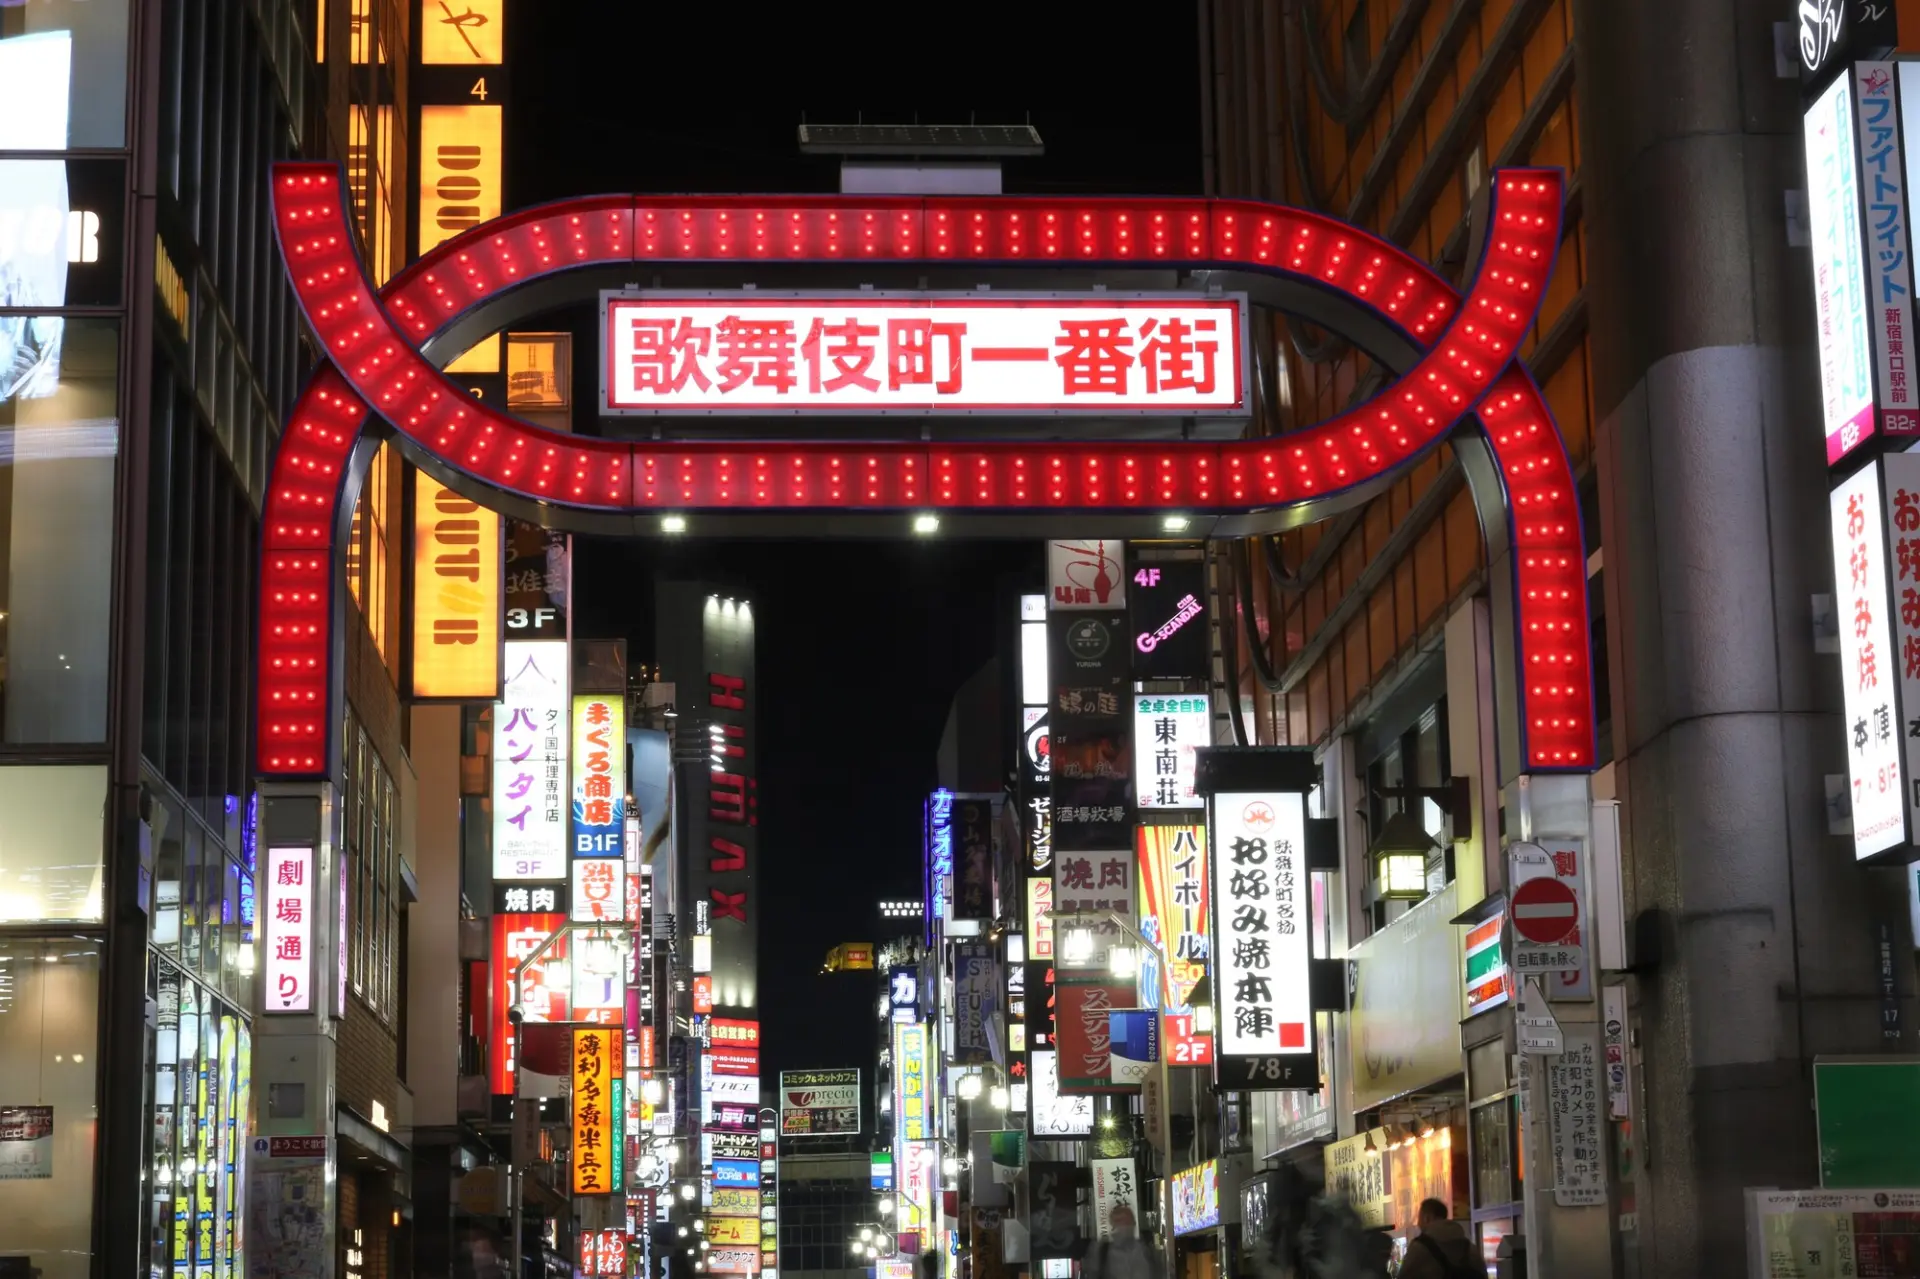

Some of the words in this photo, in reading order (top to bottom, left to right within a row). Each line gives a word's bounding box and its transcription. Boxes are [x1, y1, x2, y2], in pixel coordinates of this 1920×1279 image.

[471, 78, 487, 102] 4
[1862, 98, 1906, 306] ファイトフィット
[632, 316, 1219, 394] 歌舞伎町一番街
[1886, 310, 1907, 404] 新宿東口駅前
[1884, 412, 1918, 431] B2F
[1134, 568, 1161, 587] 4F
[507, 608, 556, 628] 3F
[1138, 700, 1206, 714] 全卓全自動
[503, 707, 538, 831] バンタイ
[544, 708, 559, 823] タイ国料理専門店
[584, 702, 611, 826] まぐろ商店
[1154, 717, 1178, 806] 東南荘
[576, 834, 620, 852] B1F
[516, 862, 542, 874] 3F
[1060, 857, 1129, 890] 焼肉
[504, 889, 557, 912] 焼肉
[1173, 831, 1201, 960] ハイボール
[1274, 840, 1296, 936] 歌舞伎町名物
[275, 859, 304, 998] 劇場通り
[1230, 836, 1275, 1039] お好み焼本陣
[1516, 950, 1577, 969] 自転車を除く
[584, 1007, 613, 1023] 4F
[1884, 1010, 1899, 1022] 17
[1175, 1043, 1207, 1063] 2F
[784, 1072, 857, 1084] コミック&ネットカフェ
[1568, 1051, 1588, 1178] 防犯カメラ作動中
[1582, 1043, 1600, 1185] みなさまの安全を守ります
[710, 1225, 741, 1240] ゲーム
